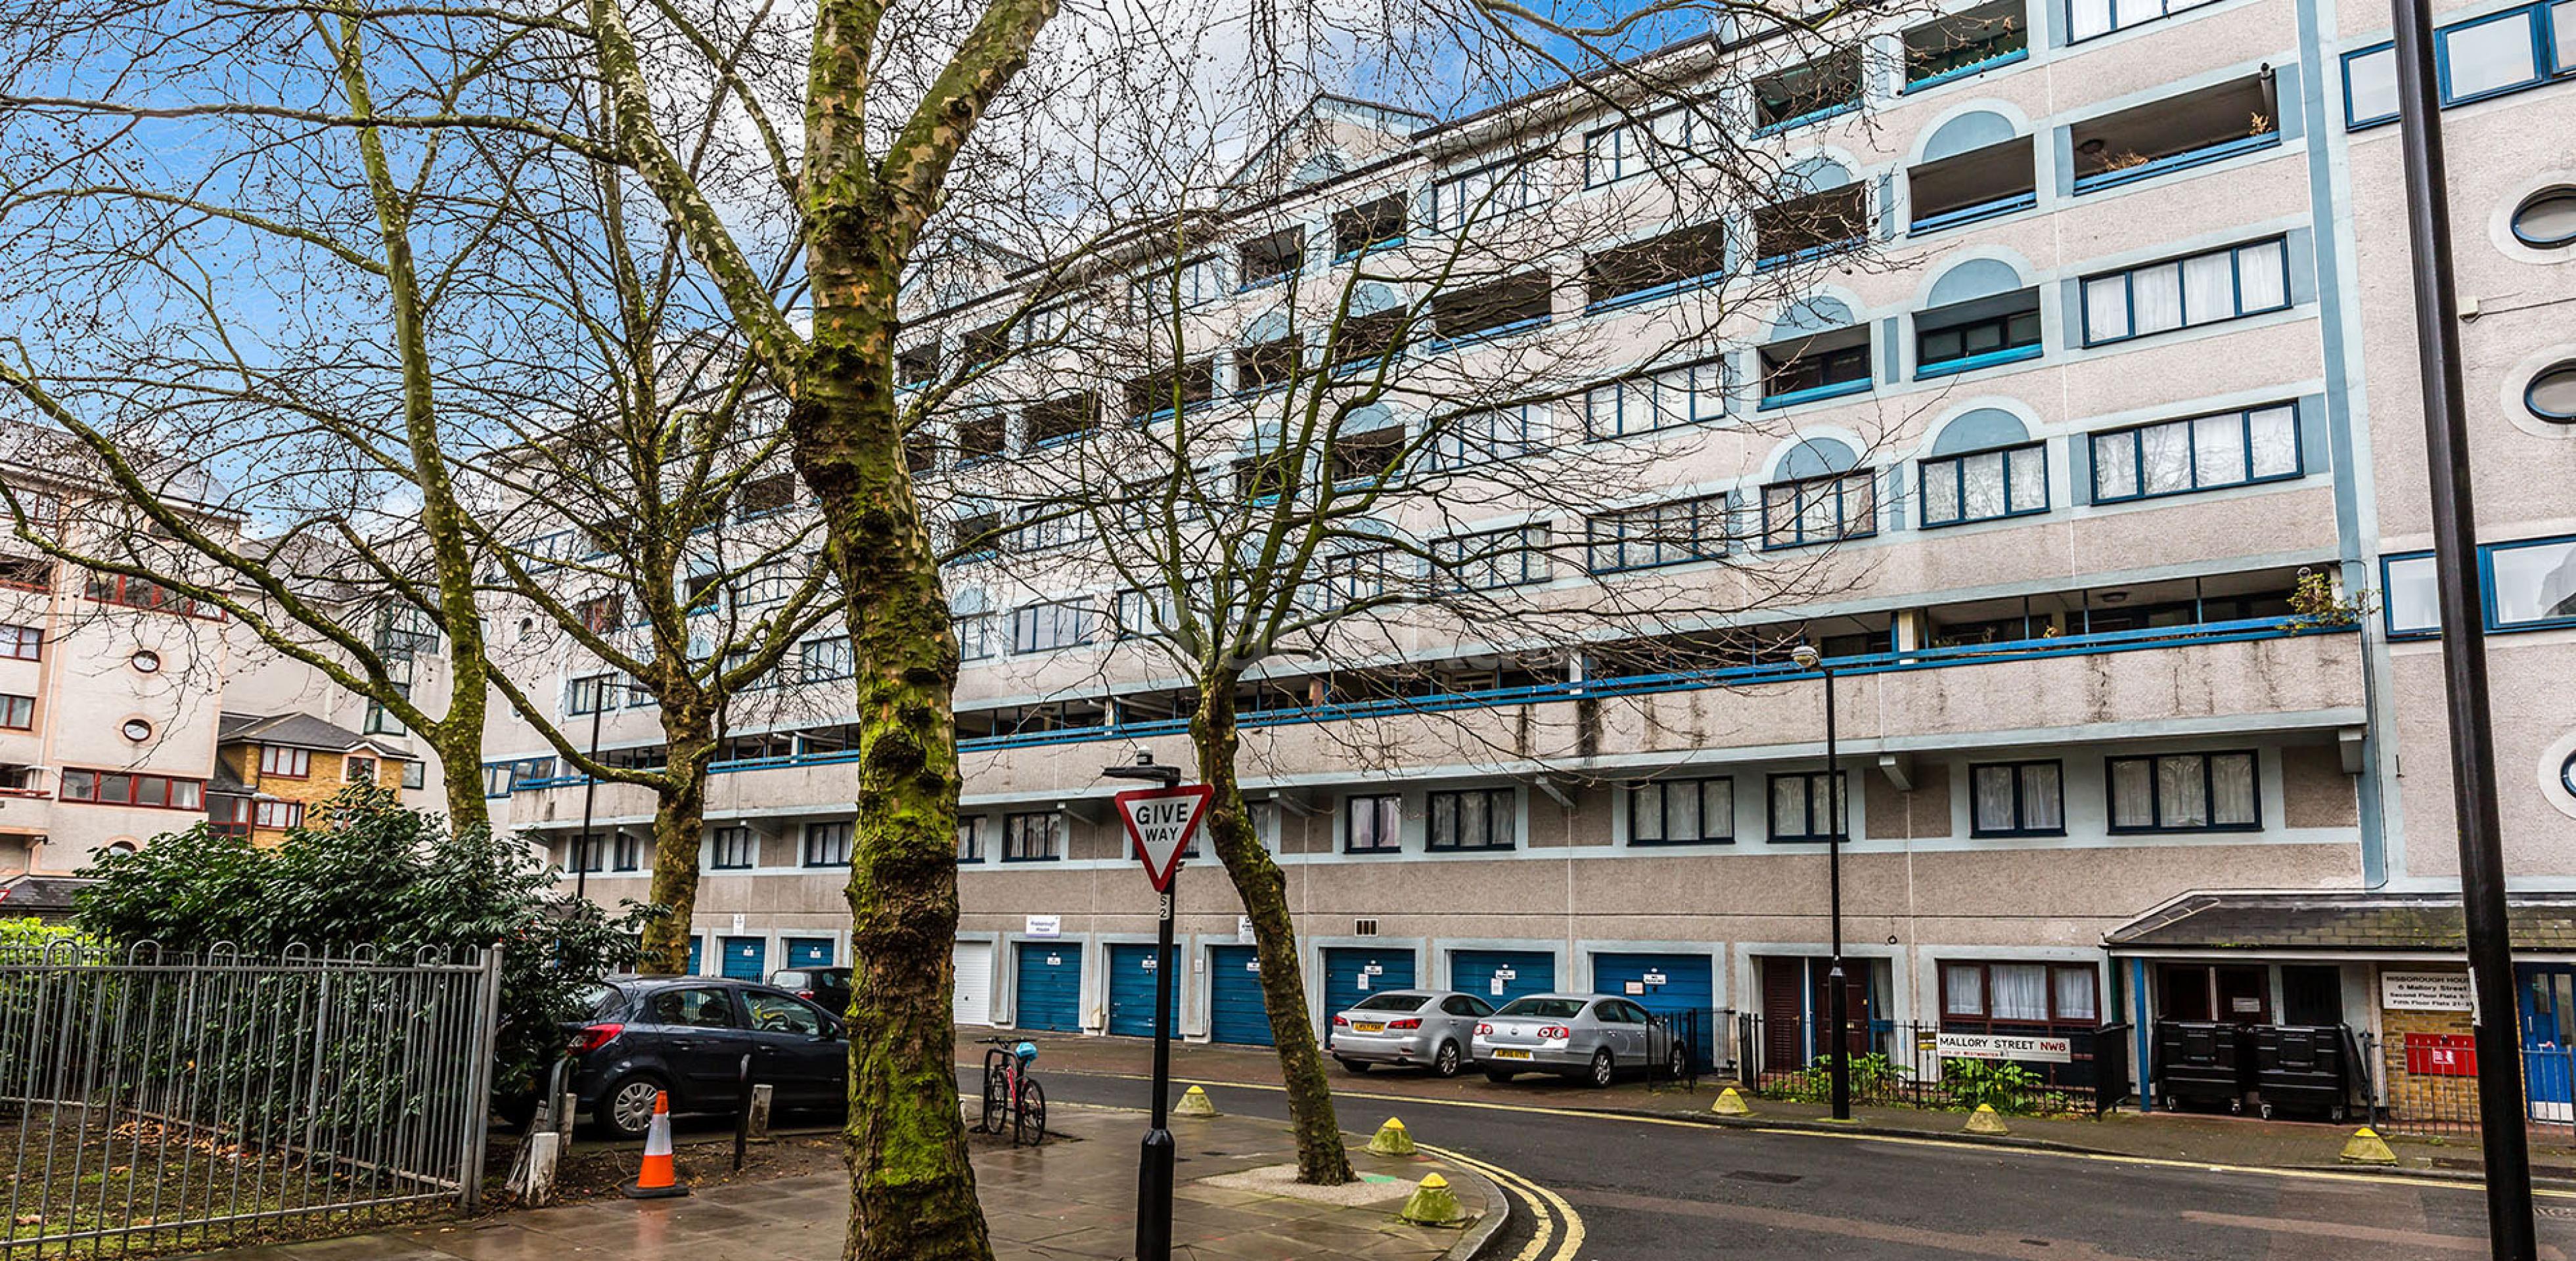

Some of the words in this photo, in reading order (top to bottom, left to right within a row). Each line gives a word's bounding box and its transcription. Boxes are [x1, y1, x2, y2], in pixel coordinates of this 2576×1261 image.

[1136, 803, 1188, 825] GIVE
[1145, 827, 1179, 842] WAY
[1939, 1037, 1989, 1048] MALLORY
[1994, 1039, 2035, 1050] STREET
[2040, 1042, 2067, 1052] NW8
